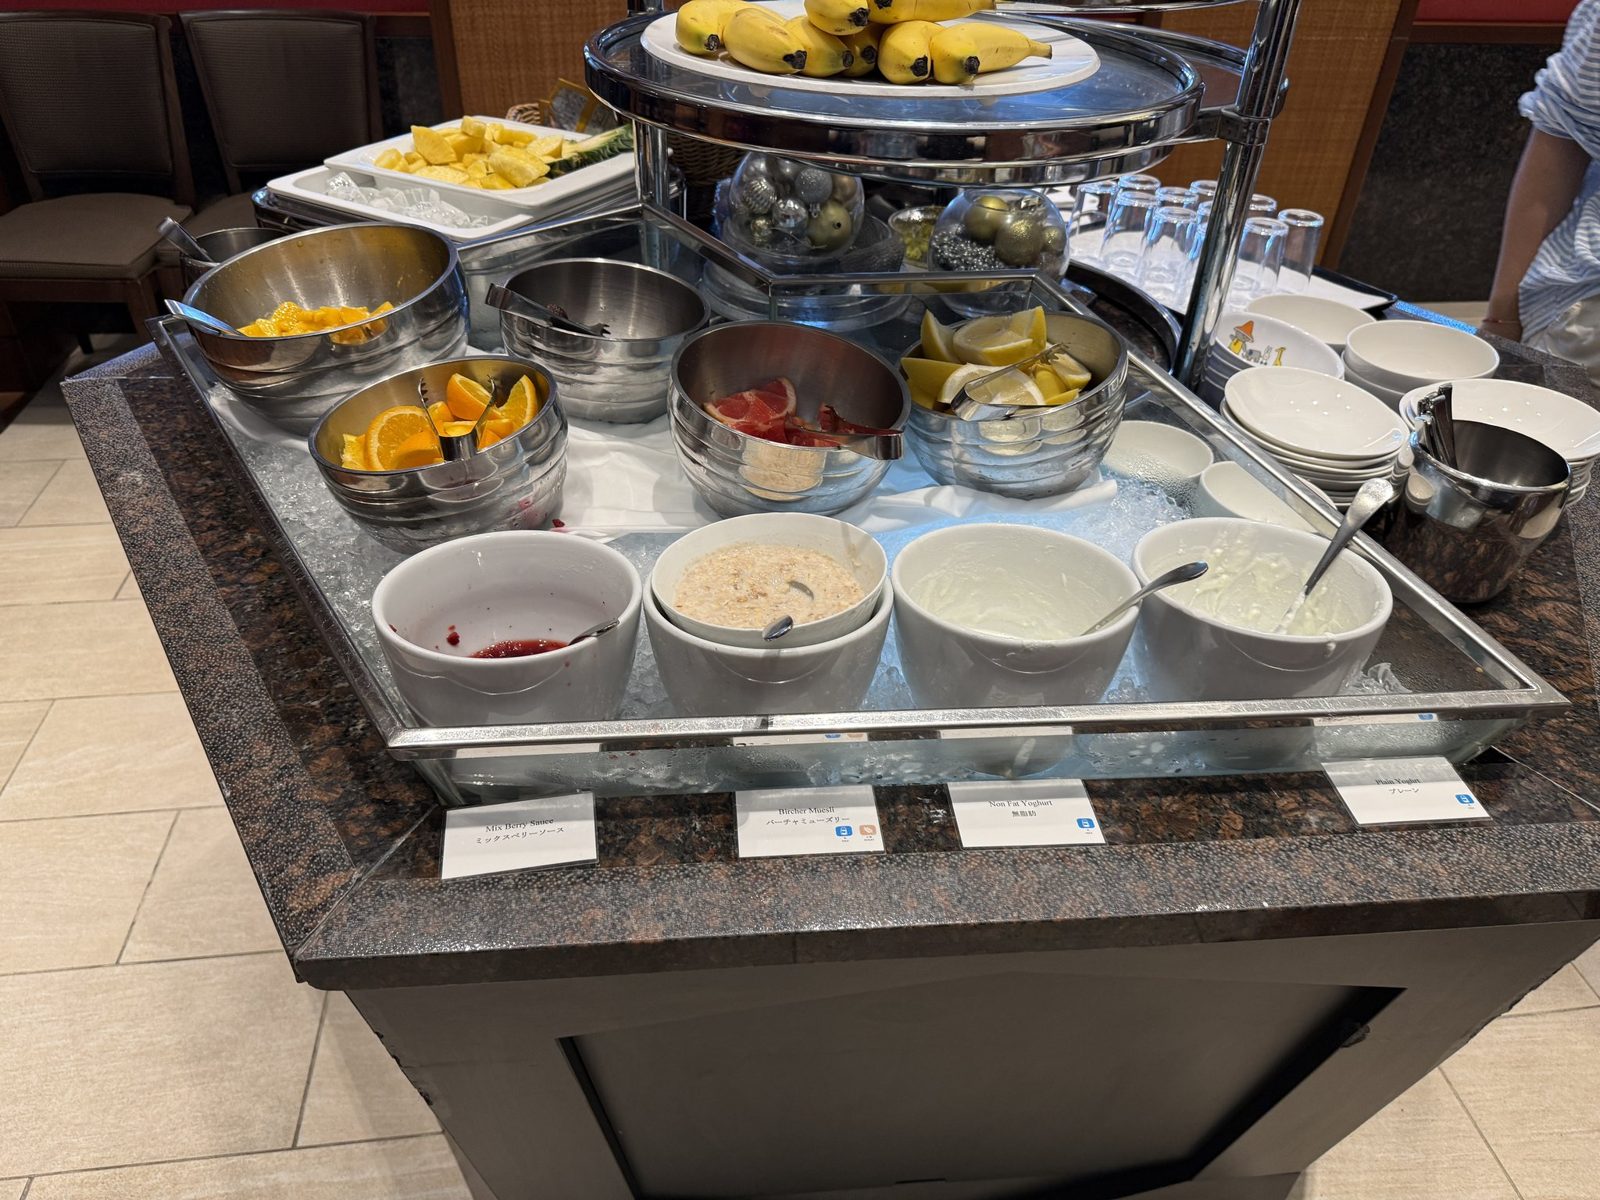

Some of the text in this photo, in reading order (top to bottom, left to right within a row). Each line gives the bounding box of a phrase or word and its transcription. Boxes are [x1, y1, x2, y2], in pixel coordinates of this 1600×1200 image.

[989, 799, 1053, 808] Non Fat Yoghurt
[778, 806, 835, 816] Bircher Muesli
[485, 818, 554, 833] Mix Berry Sauce
